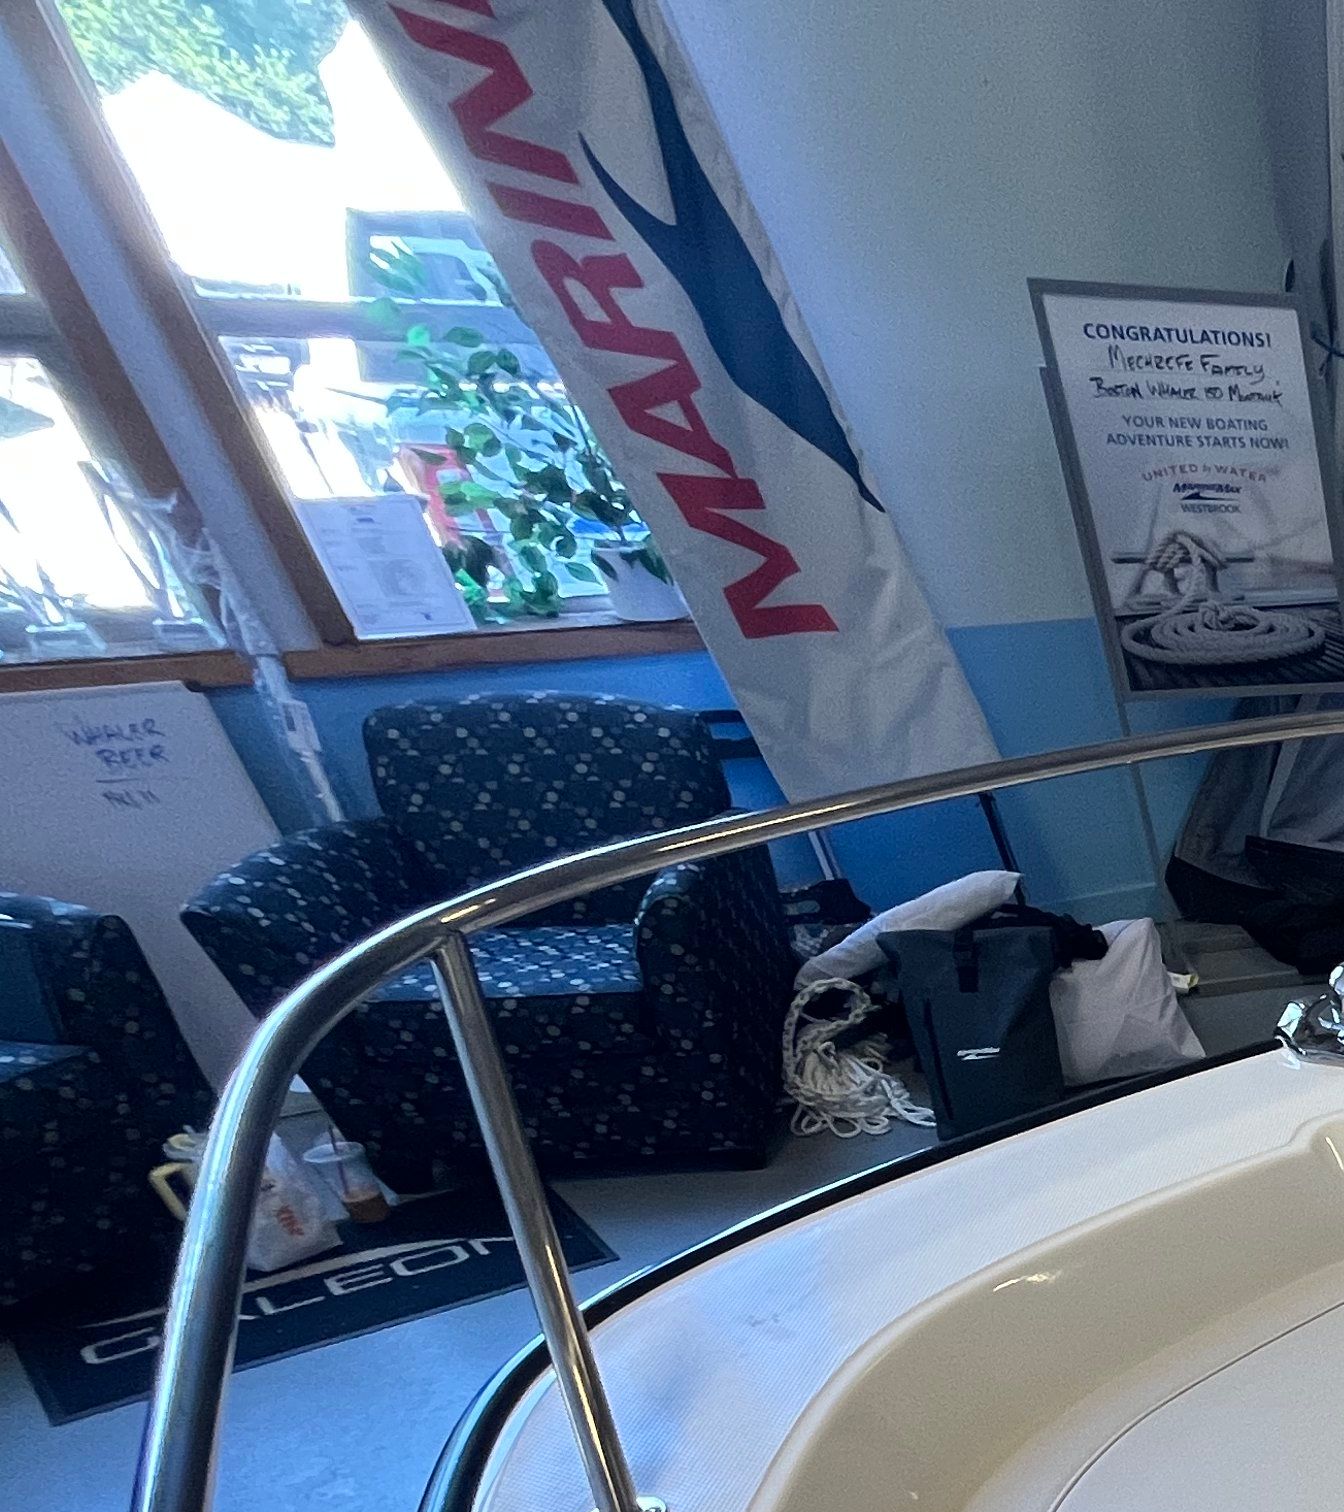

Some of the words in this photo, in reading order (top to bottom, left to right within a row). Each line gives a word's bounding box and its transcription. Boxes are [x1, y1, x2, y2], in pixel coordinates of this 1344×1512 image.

[395, 0, 839, 640] MARIN
[1083, 323, 1271, 347] CONGRATULATIONS!
[1122, 415, 1165, 428] YOUR
[1169, 416, 1202, 429] NEW
[1206, 418, 1268, 431] BOATING
[1106, 433, 1193, 447] ADVENTURE
[1198, 435, 1246, 449] STARTS
[1250, 437, 1290, 449] NOW!
[1142, 463, 1198, 482] UNITED
[1215, 464, 1267, 482] WATER
[1181, 503, 1242, 514] WESTBROOK
[80, 1236, 514, 1365] GLEO
